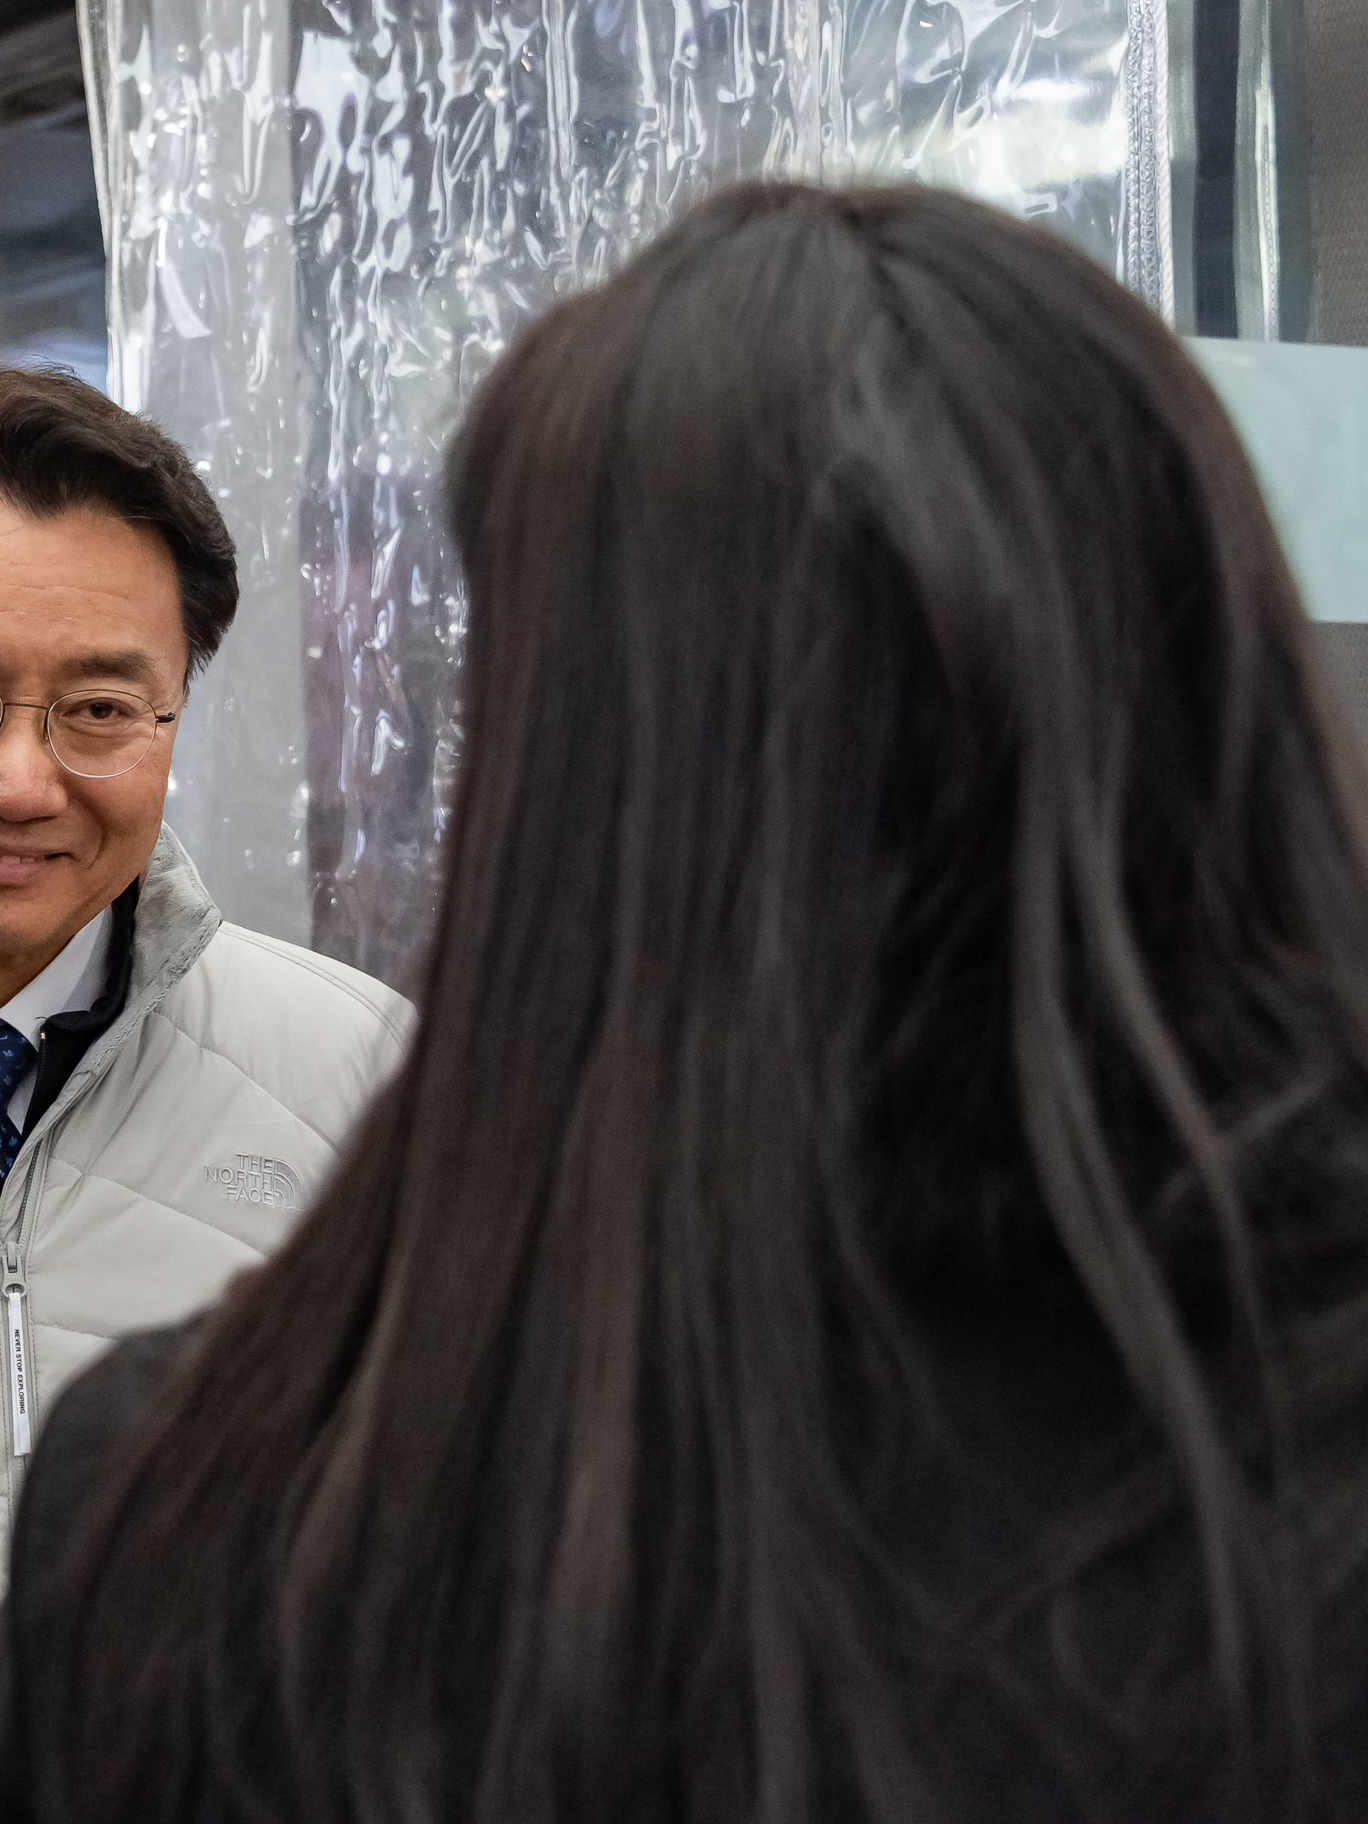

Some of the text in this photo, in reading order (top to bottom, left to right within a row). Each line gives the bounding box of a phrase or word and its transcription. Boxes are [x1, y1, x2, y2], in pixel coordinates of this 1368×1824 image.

[236, 1152, 274, 1174] THE
[203, 1165, 274, 1189] NORTH
[225, 1184, 275, 1208] FACE
[14, 1329, 26, 1414] NEVER STOP EXPLORING
